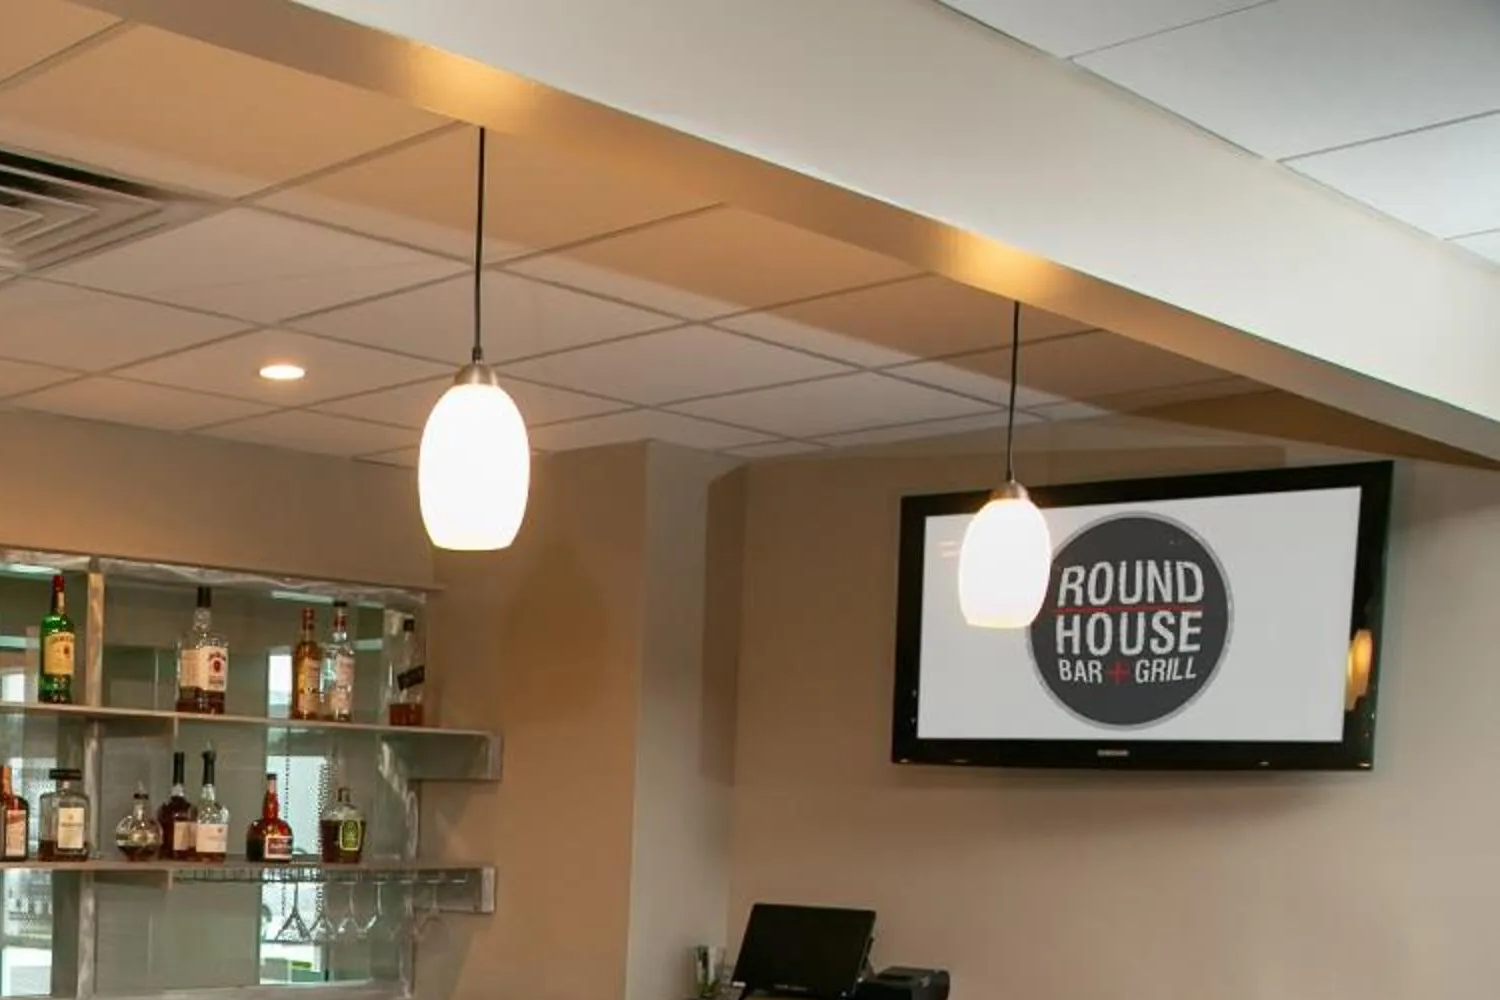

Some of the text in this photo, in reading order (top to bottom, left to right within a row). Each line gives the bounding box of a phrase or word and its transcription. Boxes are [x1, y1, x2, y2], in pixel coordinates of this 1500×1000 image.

[1057, 560, 1204, 607] ROUND
[1055, 610, 1202, 656] HOUSE
[1058, 658, 1102, 684] BAR
[1135, 656, 1197, 684] GRILL
